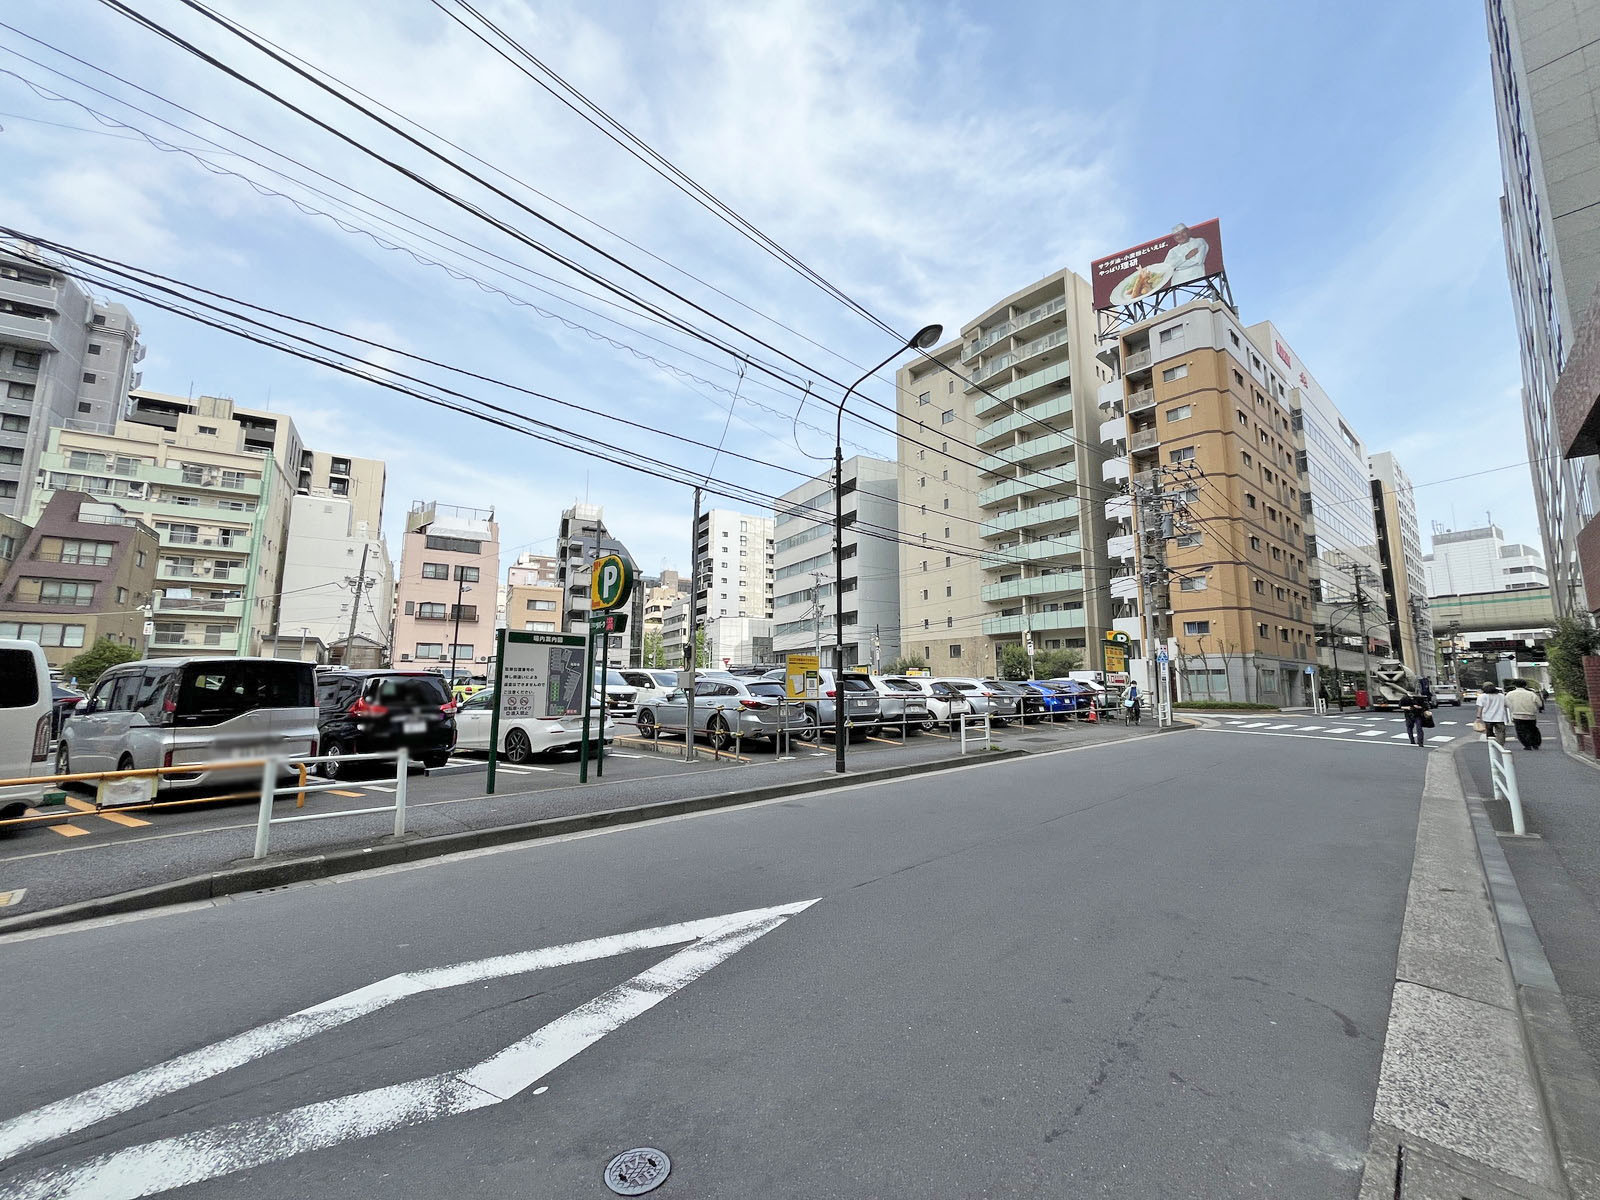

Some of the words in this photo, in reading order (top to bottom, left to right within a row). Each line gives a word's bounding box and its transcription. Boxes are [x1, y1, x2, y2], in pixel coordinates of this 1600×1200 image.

[1098, 257, 1139, 277] やっぱり理研
[603, 565, 618, 598] P
